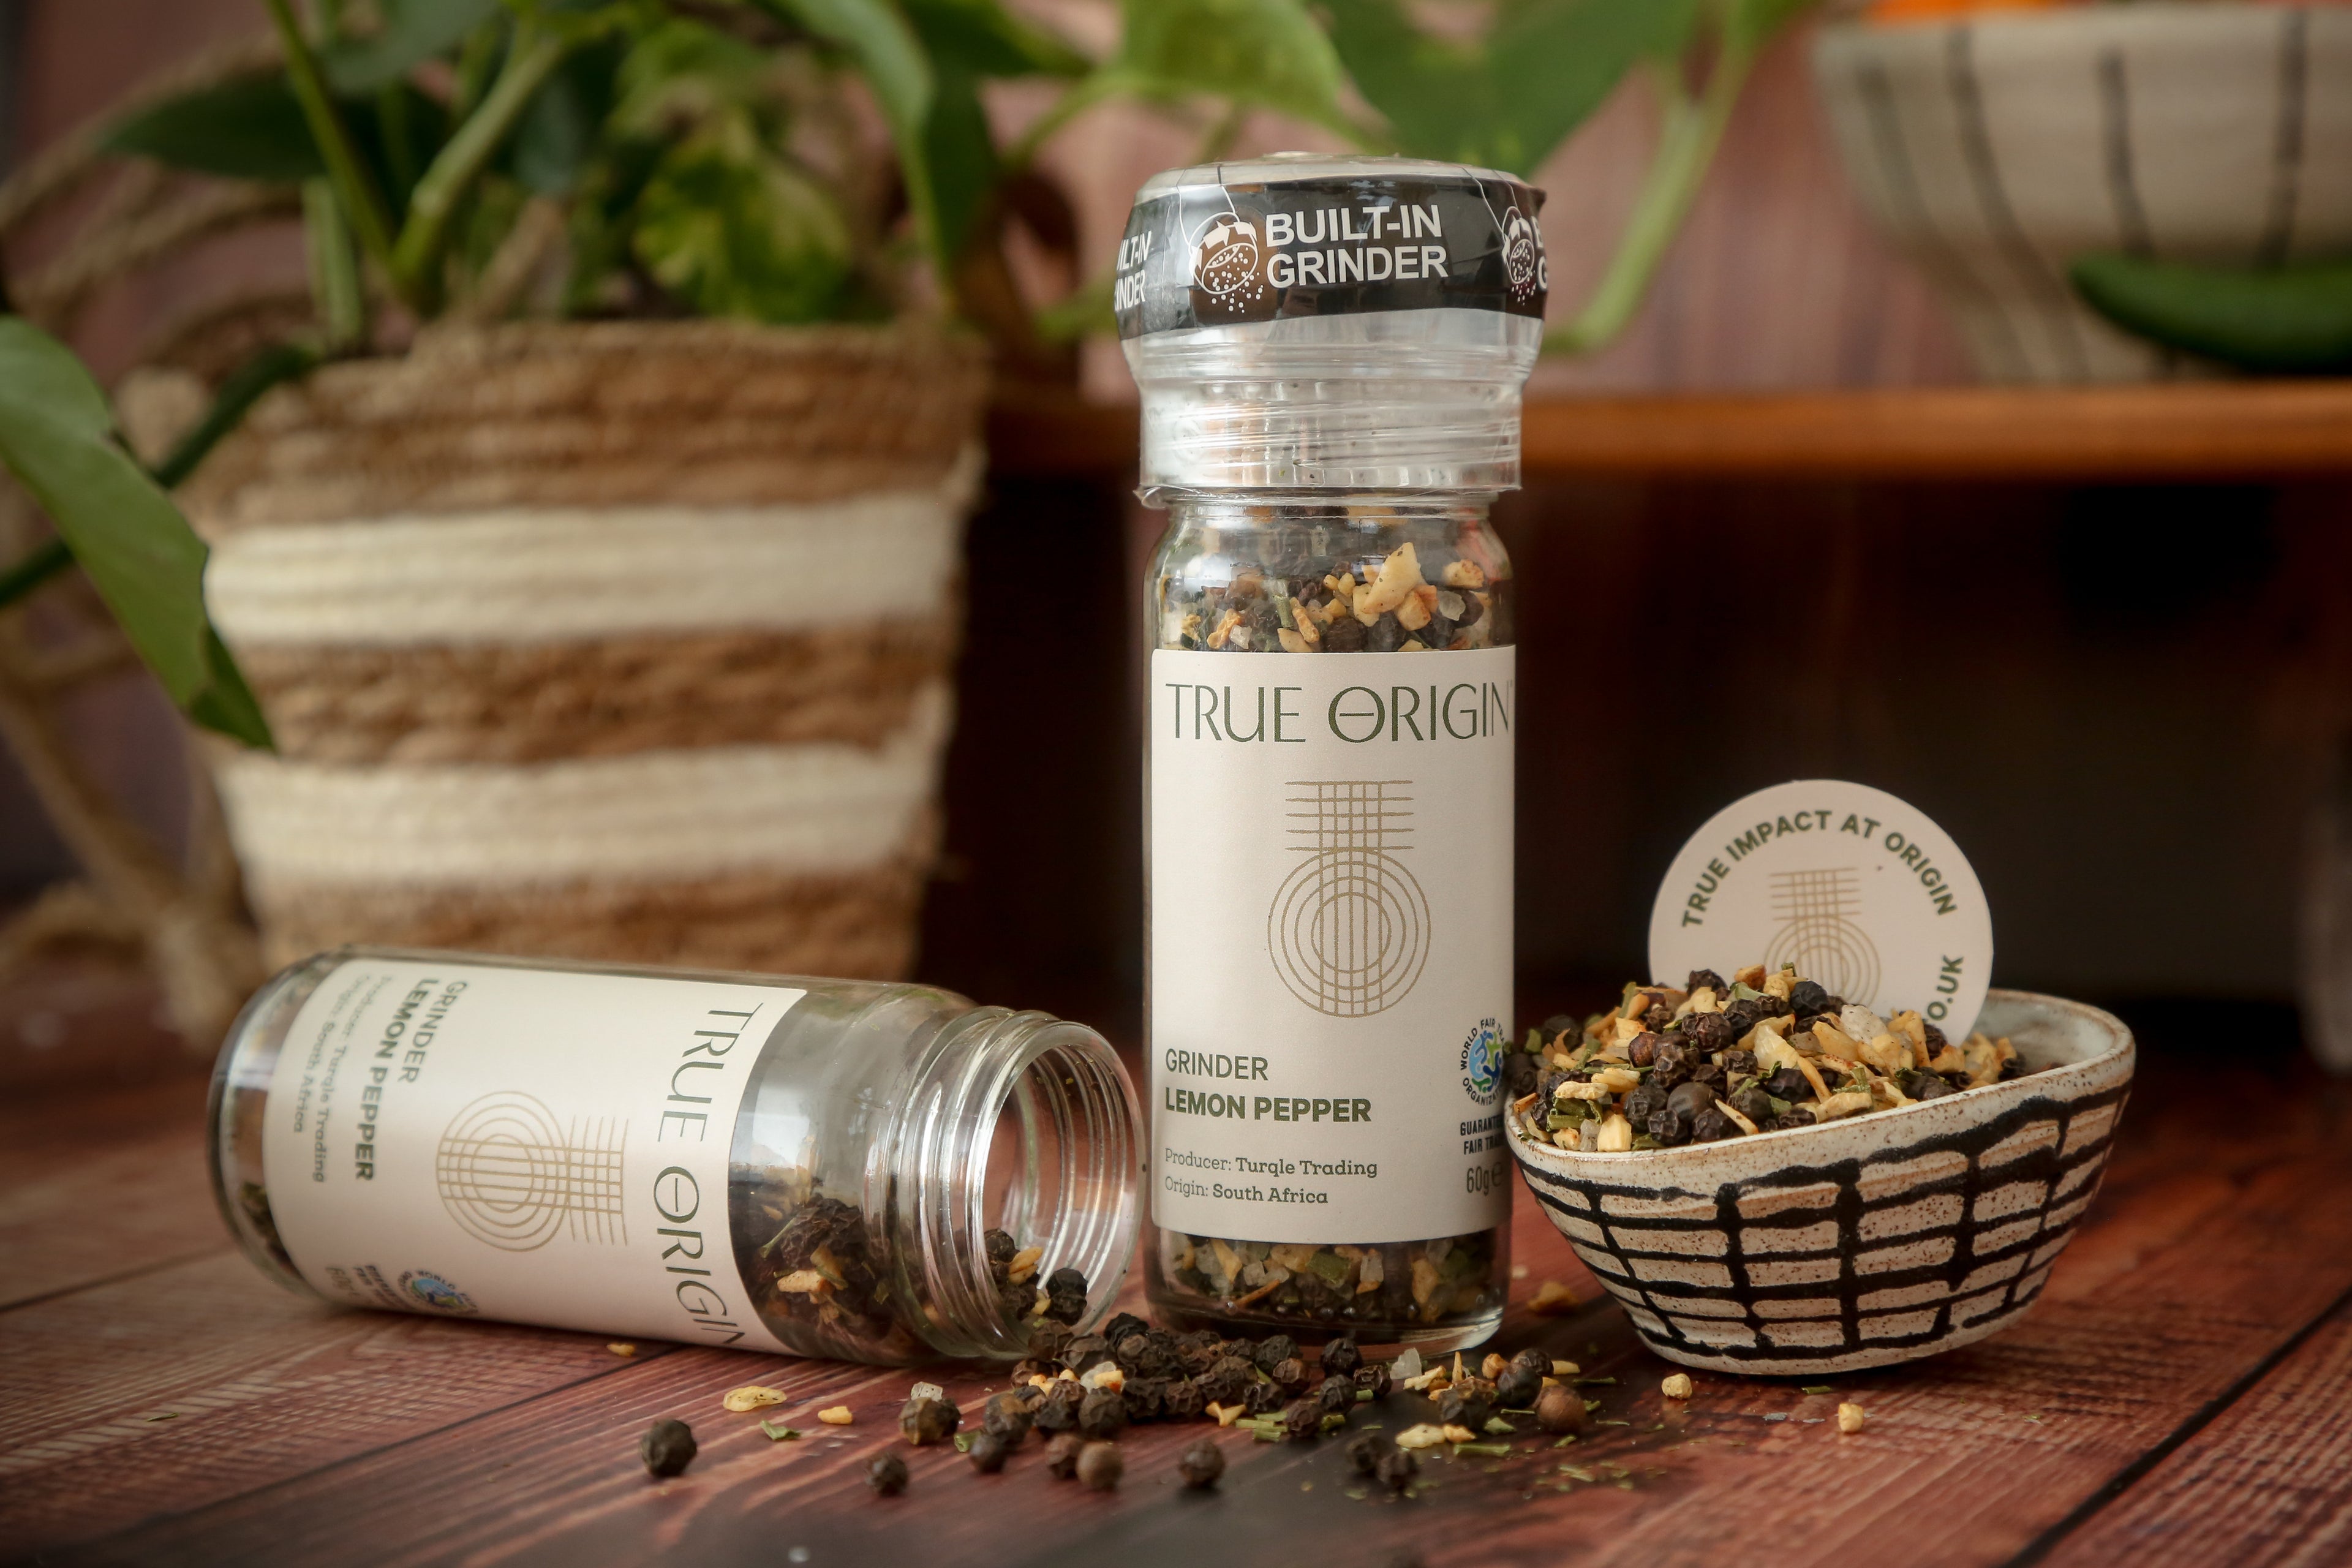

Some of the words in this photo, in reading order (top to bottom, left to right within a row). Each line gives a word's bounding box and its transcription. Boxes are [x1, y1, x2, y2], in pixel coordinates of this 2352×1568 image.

[1265, 204, 1442, 247] BUILT-IN
[1267, 245, 1449, 288] GRINDER
[1166, 683, 1306, 743] TRUE
[1328, 681, 1509, 744] ORIGIN
[1682, 858, 1730, 927] TRUE
[1725, 810, 1832, 862] IMPACT
[1841, 813, 1882, 839] AT
[1885, 832, 1958, 916] ORIGIN
[375, 978, 439, 1058] LEMON
[1926, 954, 1964, 1021] O.UK
[398, 980, 467, 1083] GRINDER
[1460, 1028, 1477, 1071] WORLD
[1480, 1018, 1495, 1030] FAIR
[658, 1002, 763, 1142] TRUE
[1166, 1049, 1268, 1080] GRINDER
[355, 1066, 388, 1181] PEPPER
[1166, 1087, 1245, 1119] LEMON
[1254, 1096, 1371, 1122] PEPPER
[312, 1107, 330, 1183] Trading
[1165, 1148, 1231, 1170] Producer:
[1235, 1158, 1295, 1177] Turqle
[1299, 1160, 1377, 1178] Trading
[1464, 1138, 1482, 1155] FAIR
[1165, 1176, 1208, 1198] Origin:
[1213, 1183, 1264, 1202] South
[1268, 1188, 1328, 1204] Africa
[653, 1166, 745, 1344] ORIGIN
